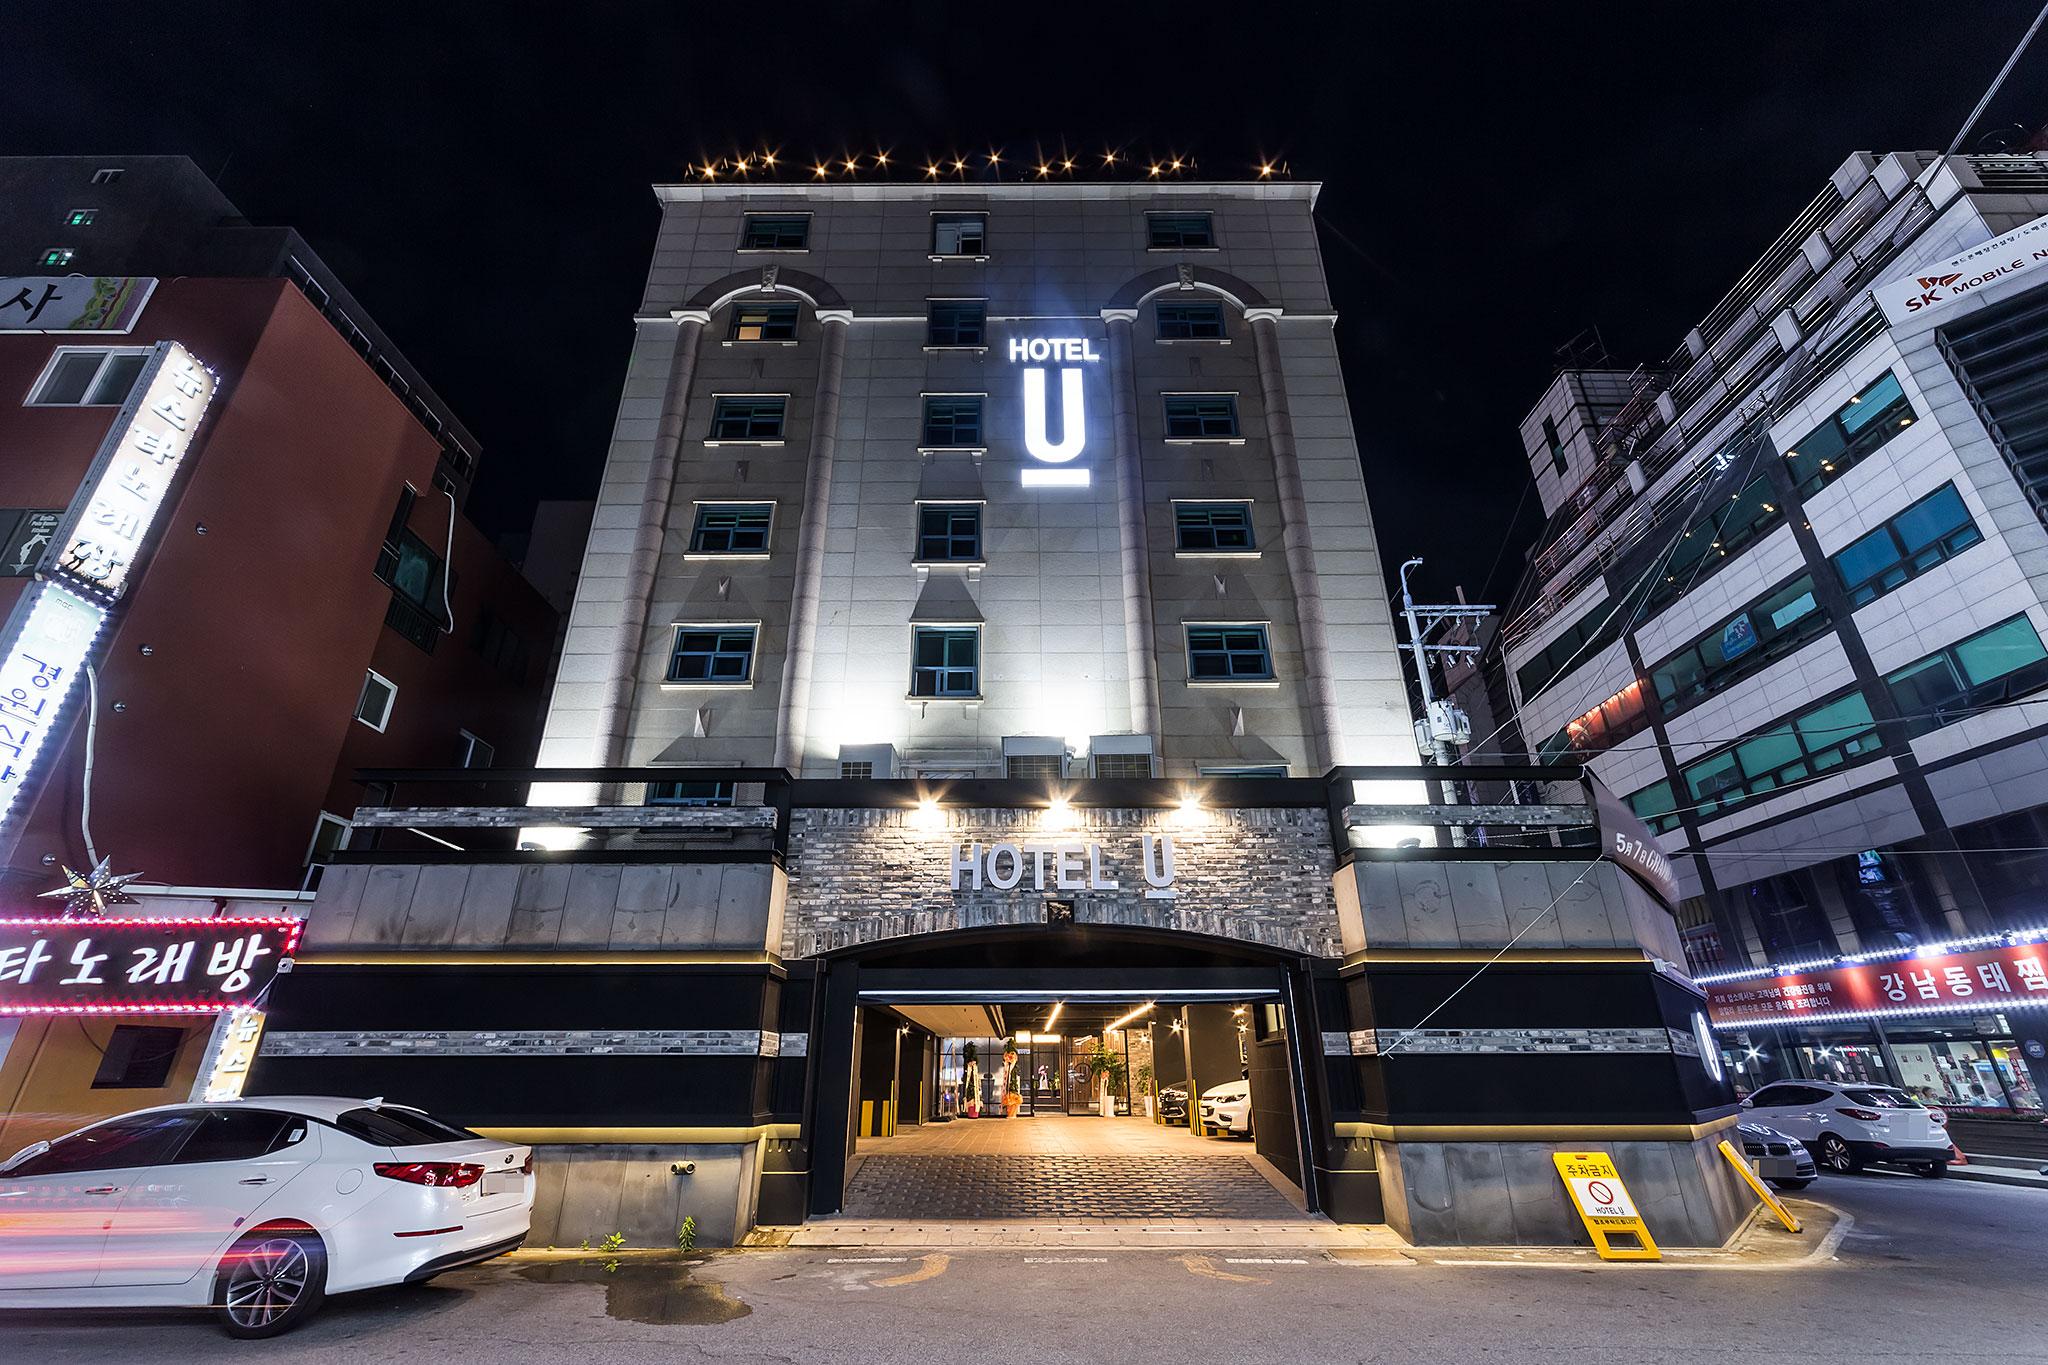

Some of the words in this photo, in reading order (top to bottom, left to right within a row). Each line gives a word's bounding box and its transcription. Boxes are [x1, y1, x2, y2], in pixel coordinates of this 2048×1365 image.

[1906, 289, 1942, 313] SK
[1952, 259, 2025, 295] MOBILE
[2032, 249, 2048, 261] N
[1009, 338, 1100, 361] HOTEL
[1023, 368, 1087, 464] U
[951, 843, 1119, 890] HOTEL
[1142, 835, 1176, 889] U
[1566, 1164, 1614, 1177] 주차금지
[1595, 1207, 1618, 1215] HOTEL
